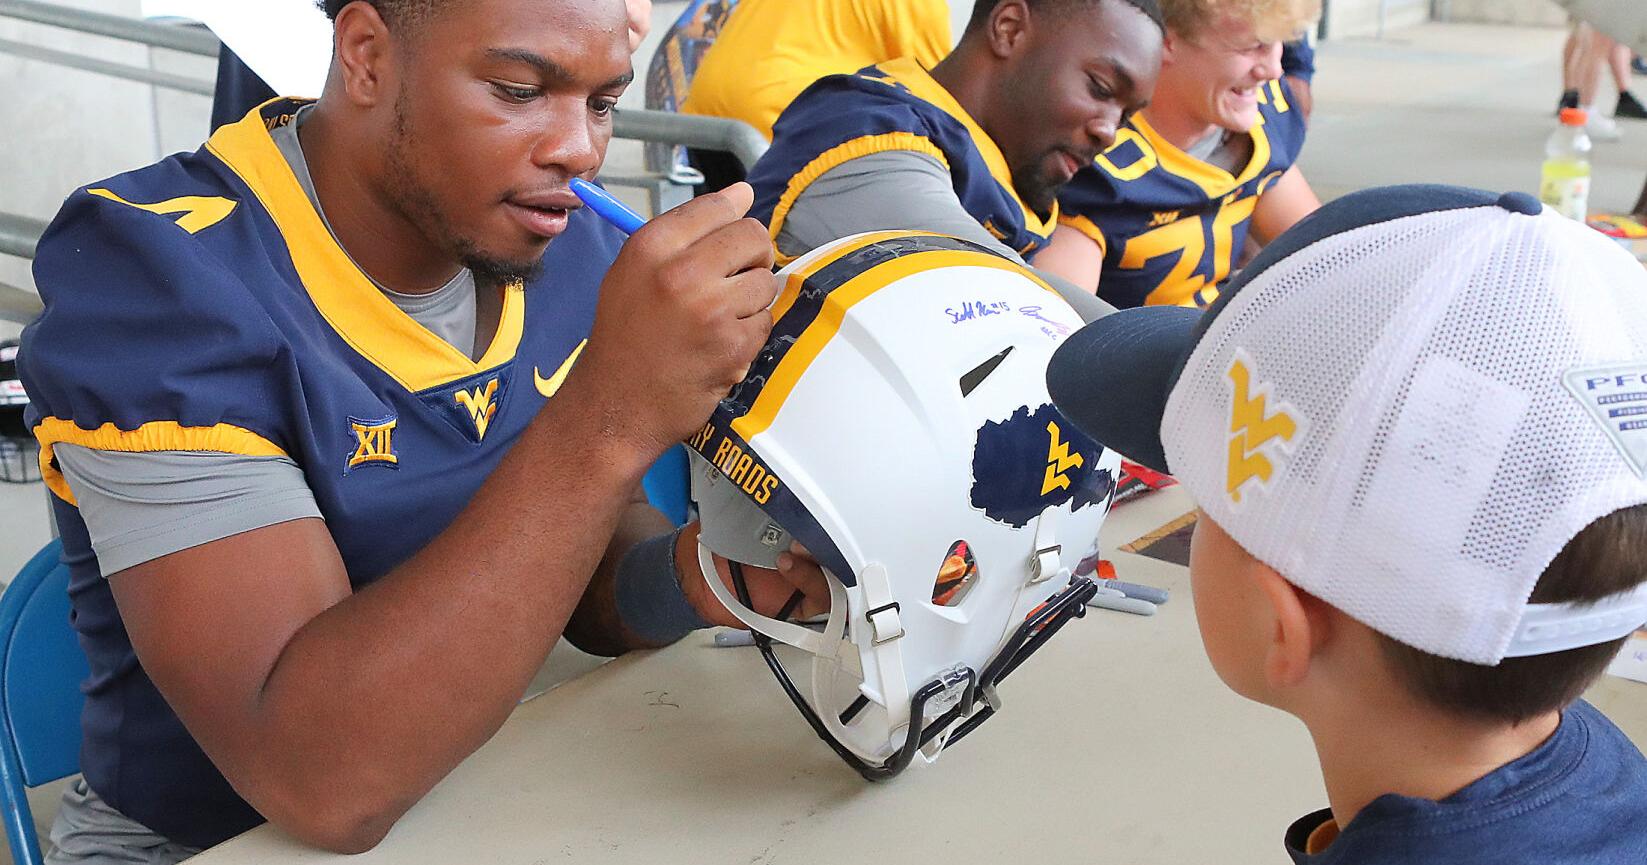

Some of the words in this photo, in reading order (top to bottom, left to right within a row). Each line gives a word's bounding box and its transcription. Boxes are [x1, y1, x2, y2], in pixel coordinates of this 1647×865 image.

[1586, 372, 1647, 390] PF
[349, 418, 398, 468] XII
[712, 436, 779, 505] ROADS
